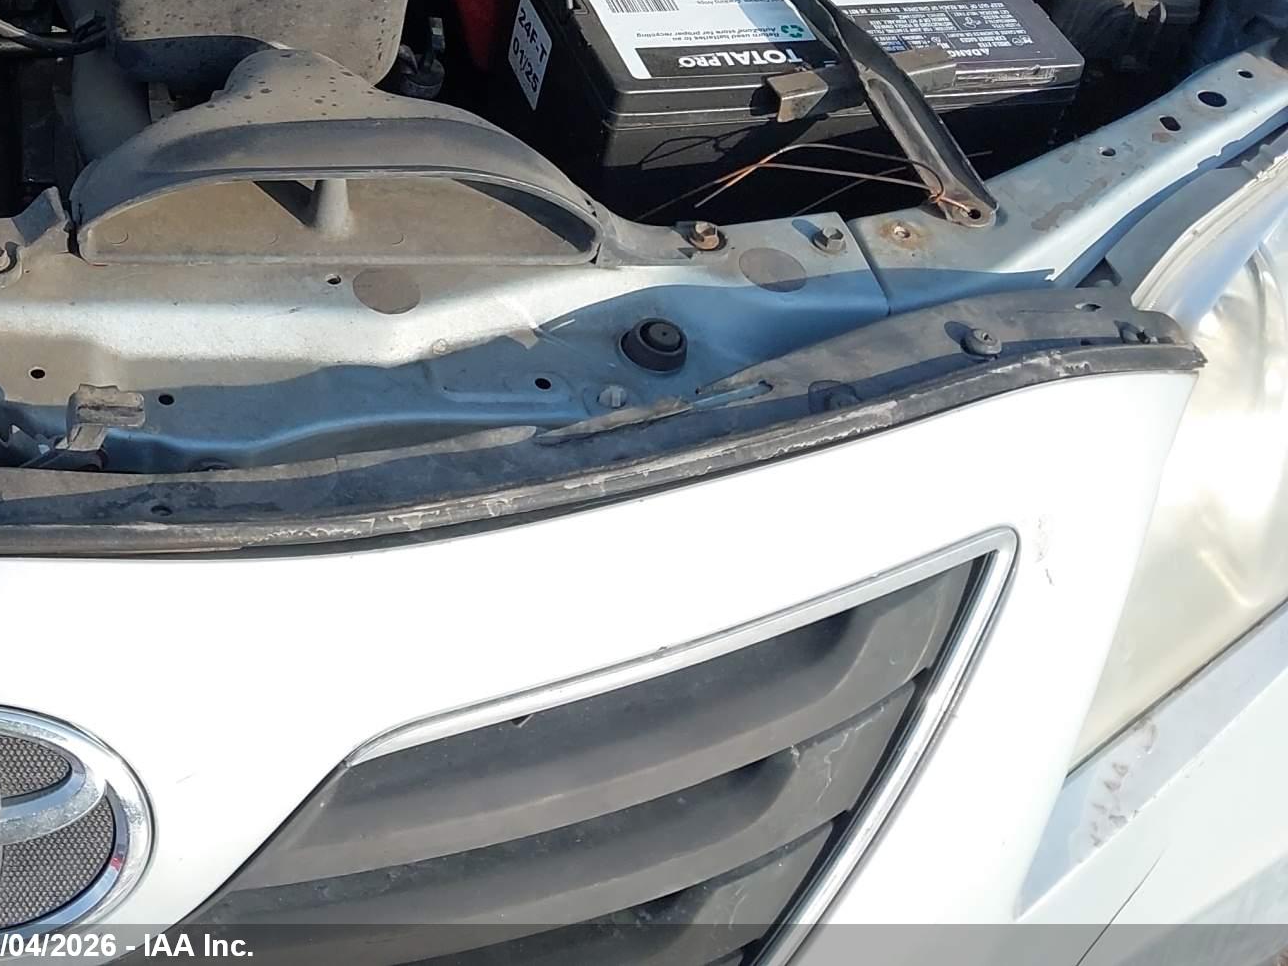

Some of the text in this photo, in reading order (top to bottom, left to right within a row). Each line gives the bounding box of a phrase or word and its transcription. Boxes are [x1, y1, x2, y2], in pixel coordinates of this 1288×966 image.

[518, 7, 548, 64] 24F-T
[947, 49, 981, 57] DANG
[513, 36, 540, 93] 01/25
[678, 48, 802, 68] TOTALPRO
